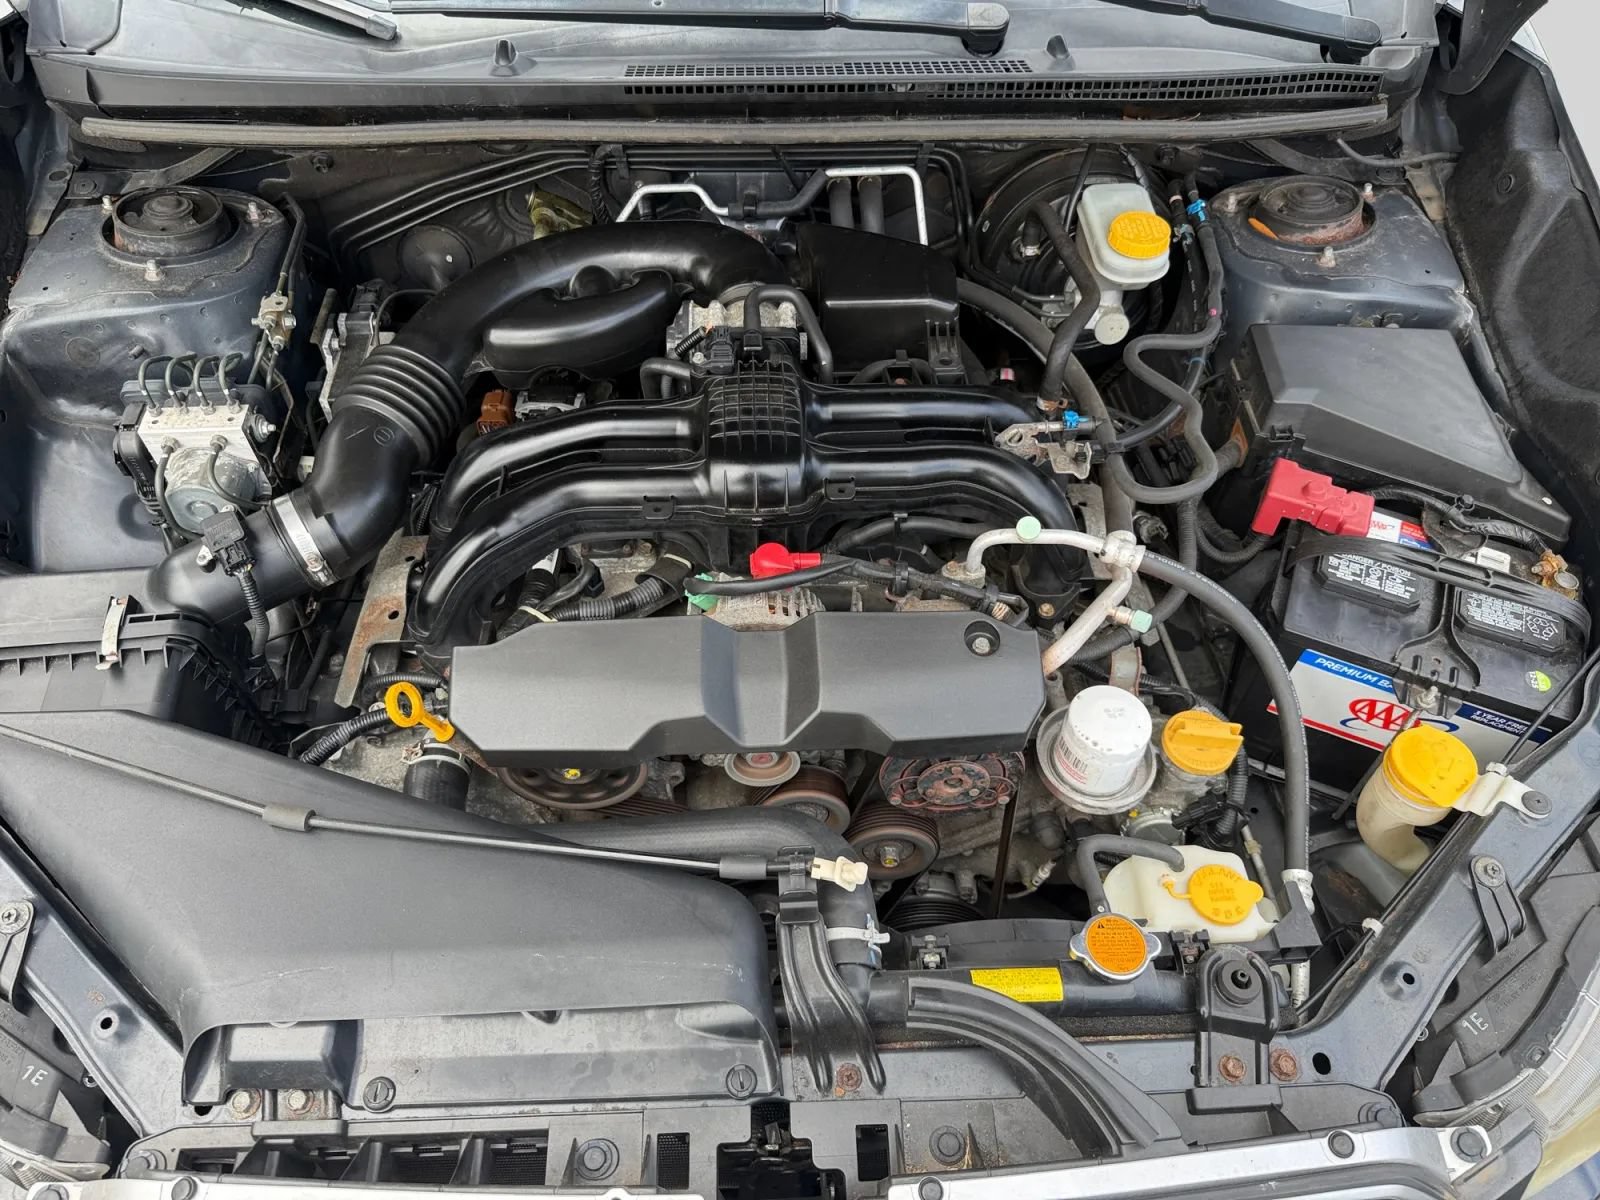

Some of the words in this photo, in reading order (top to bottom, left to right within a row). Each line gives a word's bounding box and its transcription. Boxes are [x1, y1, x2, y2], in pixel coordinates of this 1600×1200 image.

[1315, 658, 1380, 683] PREMIUM
[1350, 699, 1421, 731] AAA
[1470, 715, 1525, 735] REPLACEMENT
[1481, 713, 1507, 724] YEAR
[1462, 1012, 1489, 1036] 1E
[22, 1065, 48, 1086] 1E
